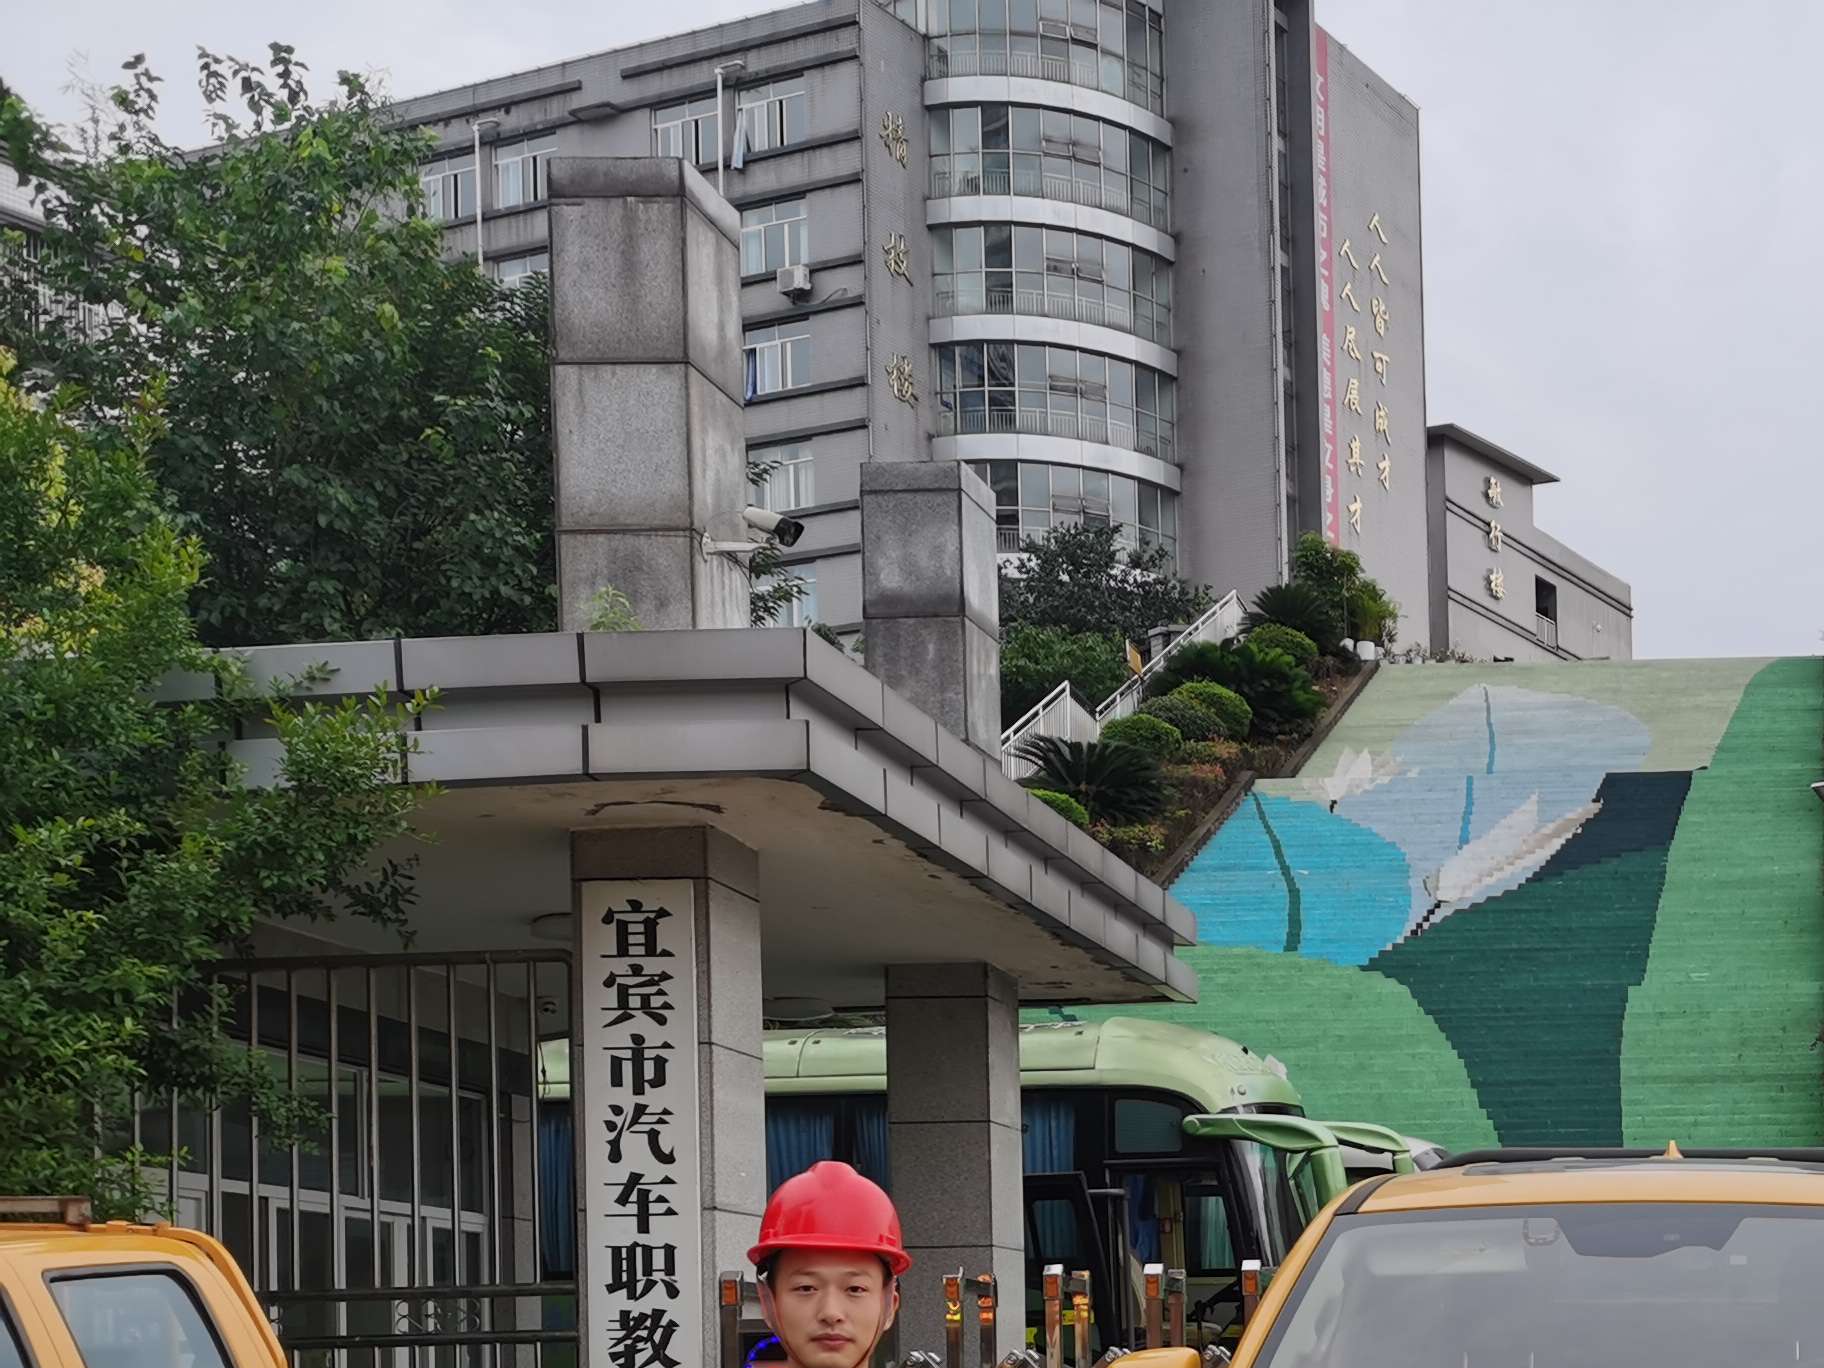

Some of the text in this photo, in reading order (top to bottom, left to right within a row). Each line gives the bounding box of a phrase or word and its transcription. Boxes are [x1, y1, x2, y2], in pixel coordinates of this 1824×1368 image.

[1339, 238, 1366, 536] 人人尽展其才
[1368, 212, 1392, 492] 人人皆可成才
